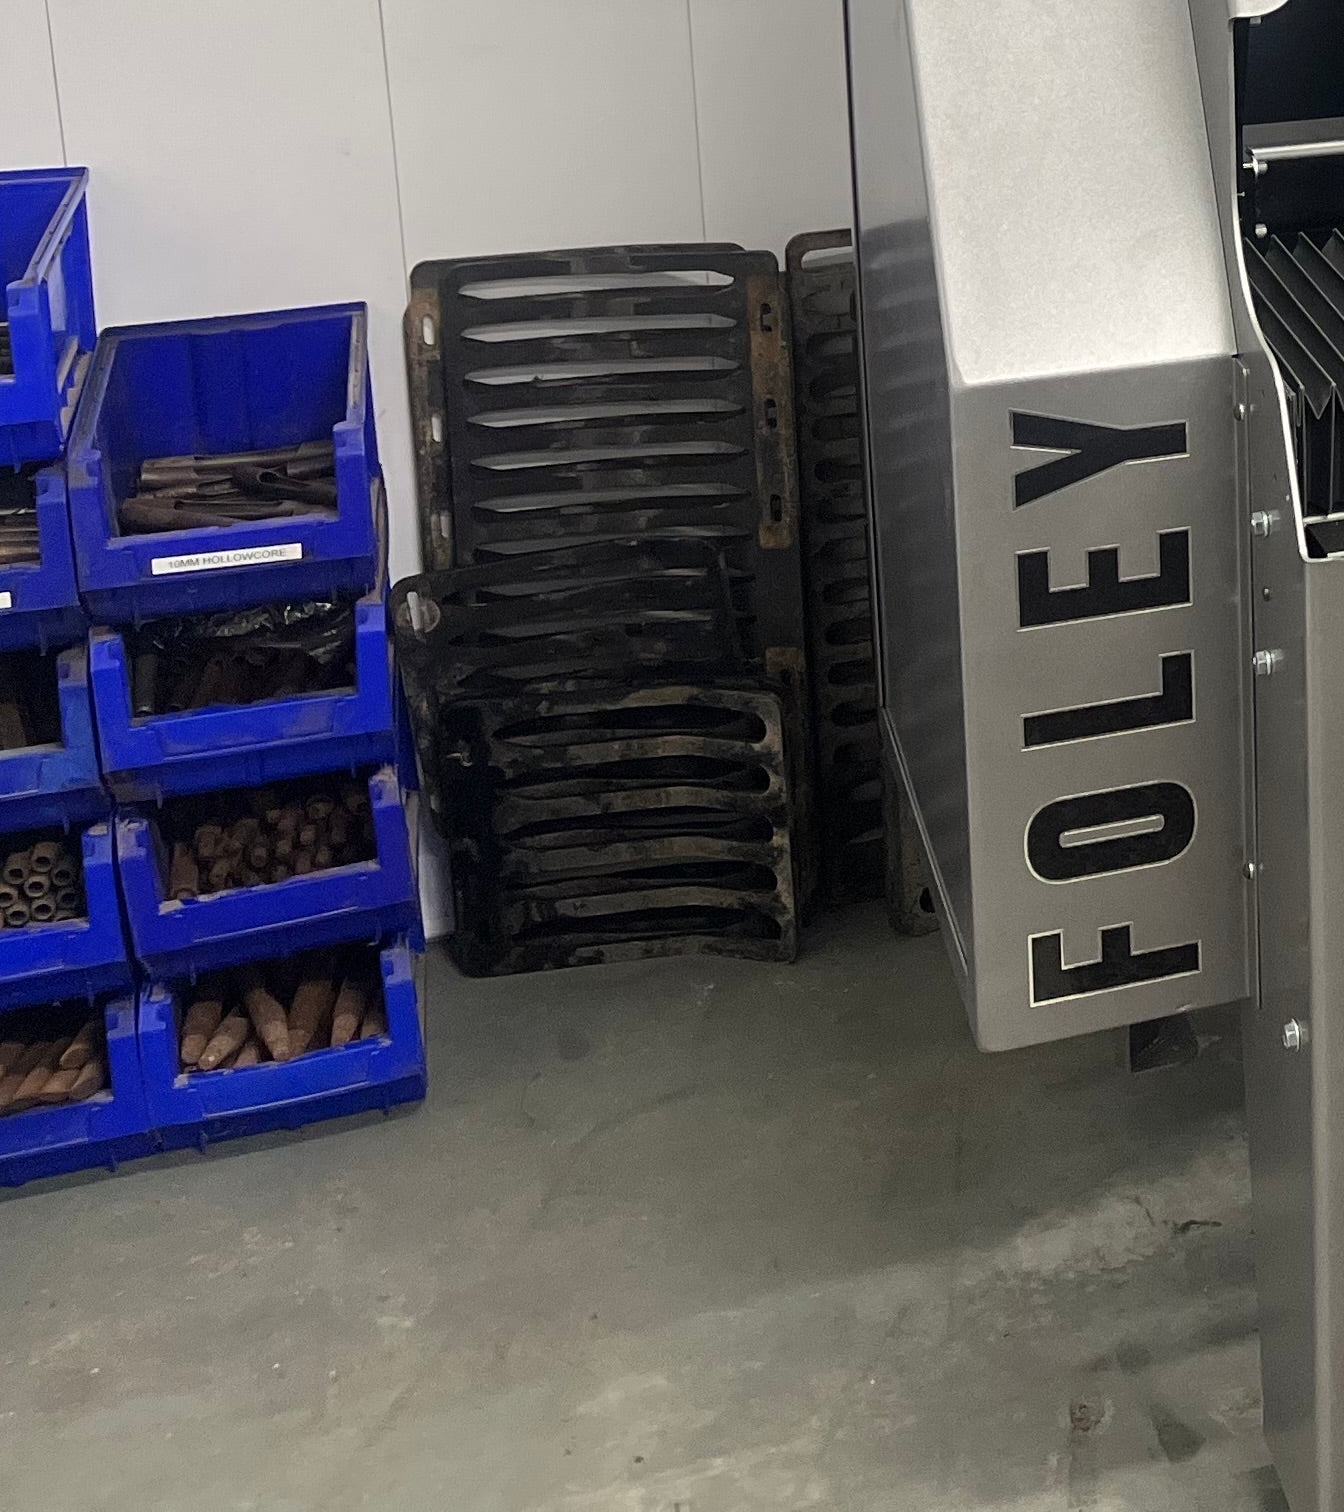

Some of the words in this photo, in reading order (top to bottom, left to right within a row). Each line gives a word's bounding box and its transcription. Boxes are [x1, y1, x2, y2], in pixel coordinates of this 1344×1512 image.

[167, 557, 201, 570] 10MM
[202, 547, 288, 566] HOLLOWCORE
[1007, 406, 1203, 1008] FOLEY
